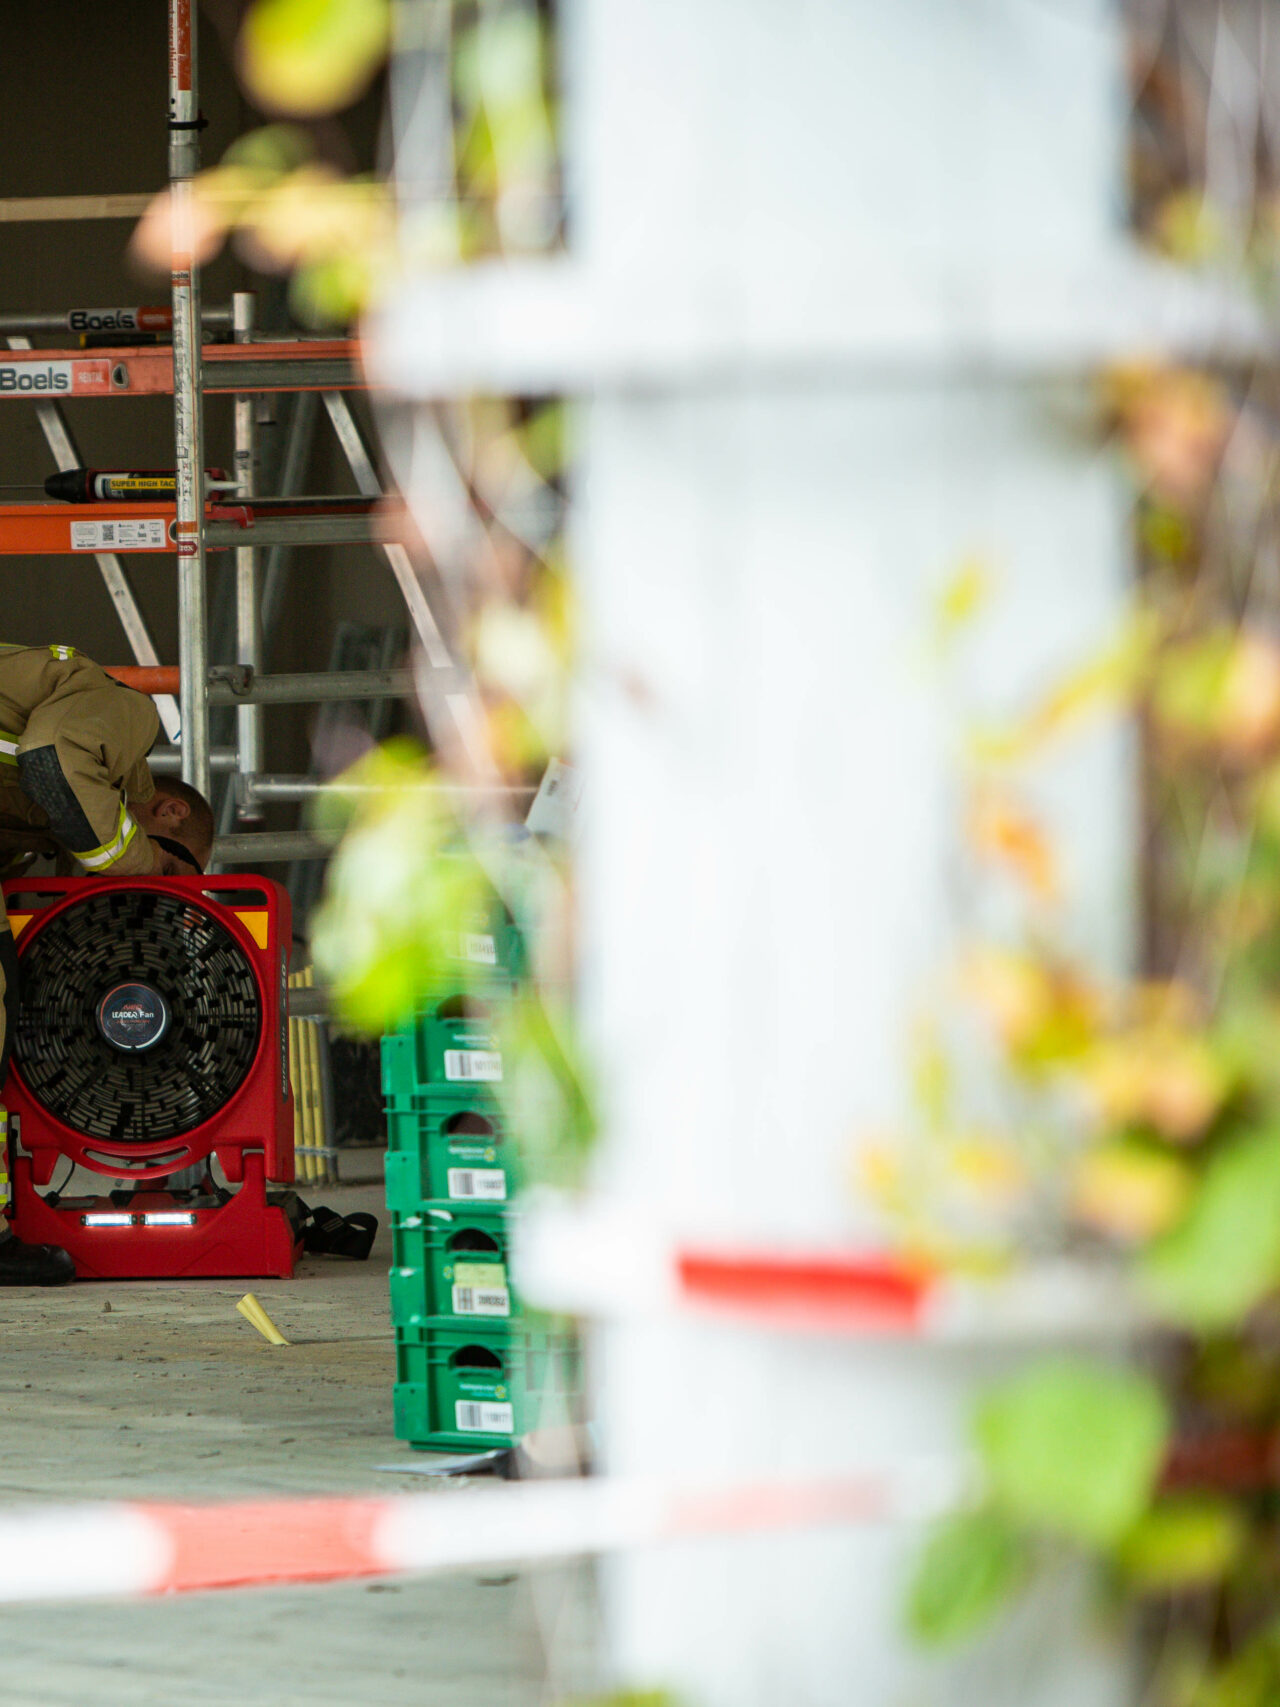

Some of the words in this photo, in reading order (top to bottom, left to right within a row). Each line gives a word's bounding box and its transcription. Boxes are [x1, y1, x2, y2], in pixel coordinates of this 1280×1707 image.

[70, 310, 136, 331] Boels
[78, 371, 105, 384] RENTAL
[111, 480, 137, 488] SUPER
[159, 480, 177, 488] TAC
